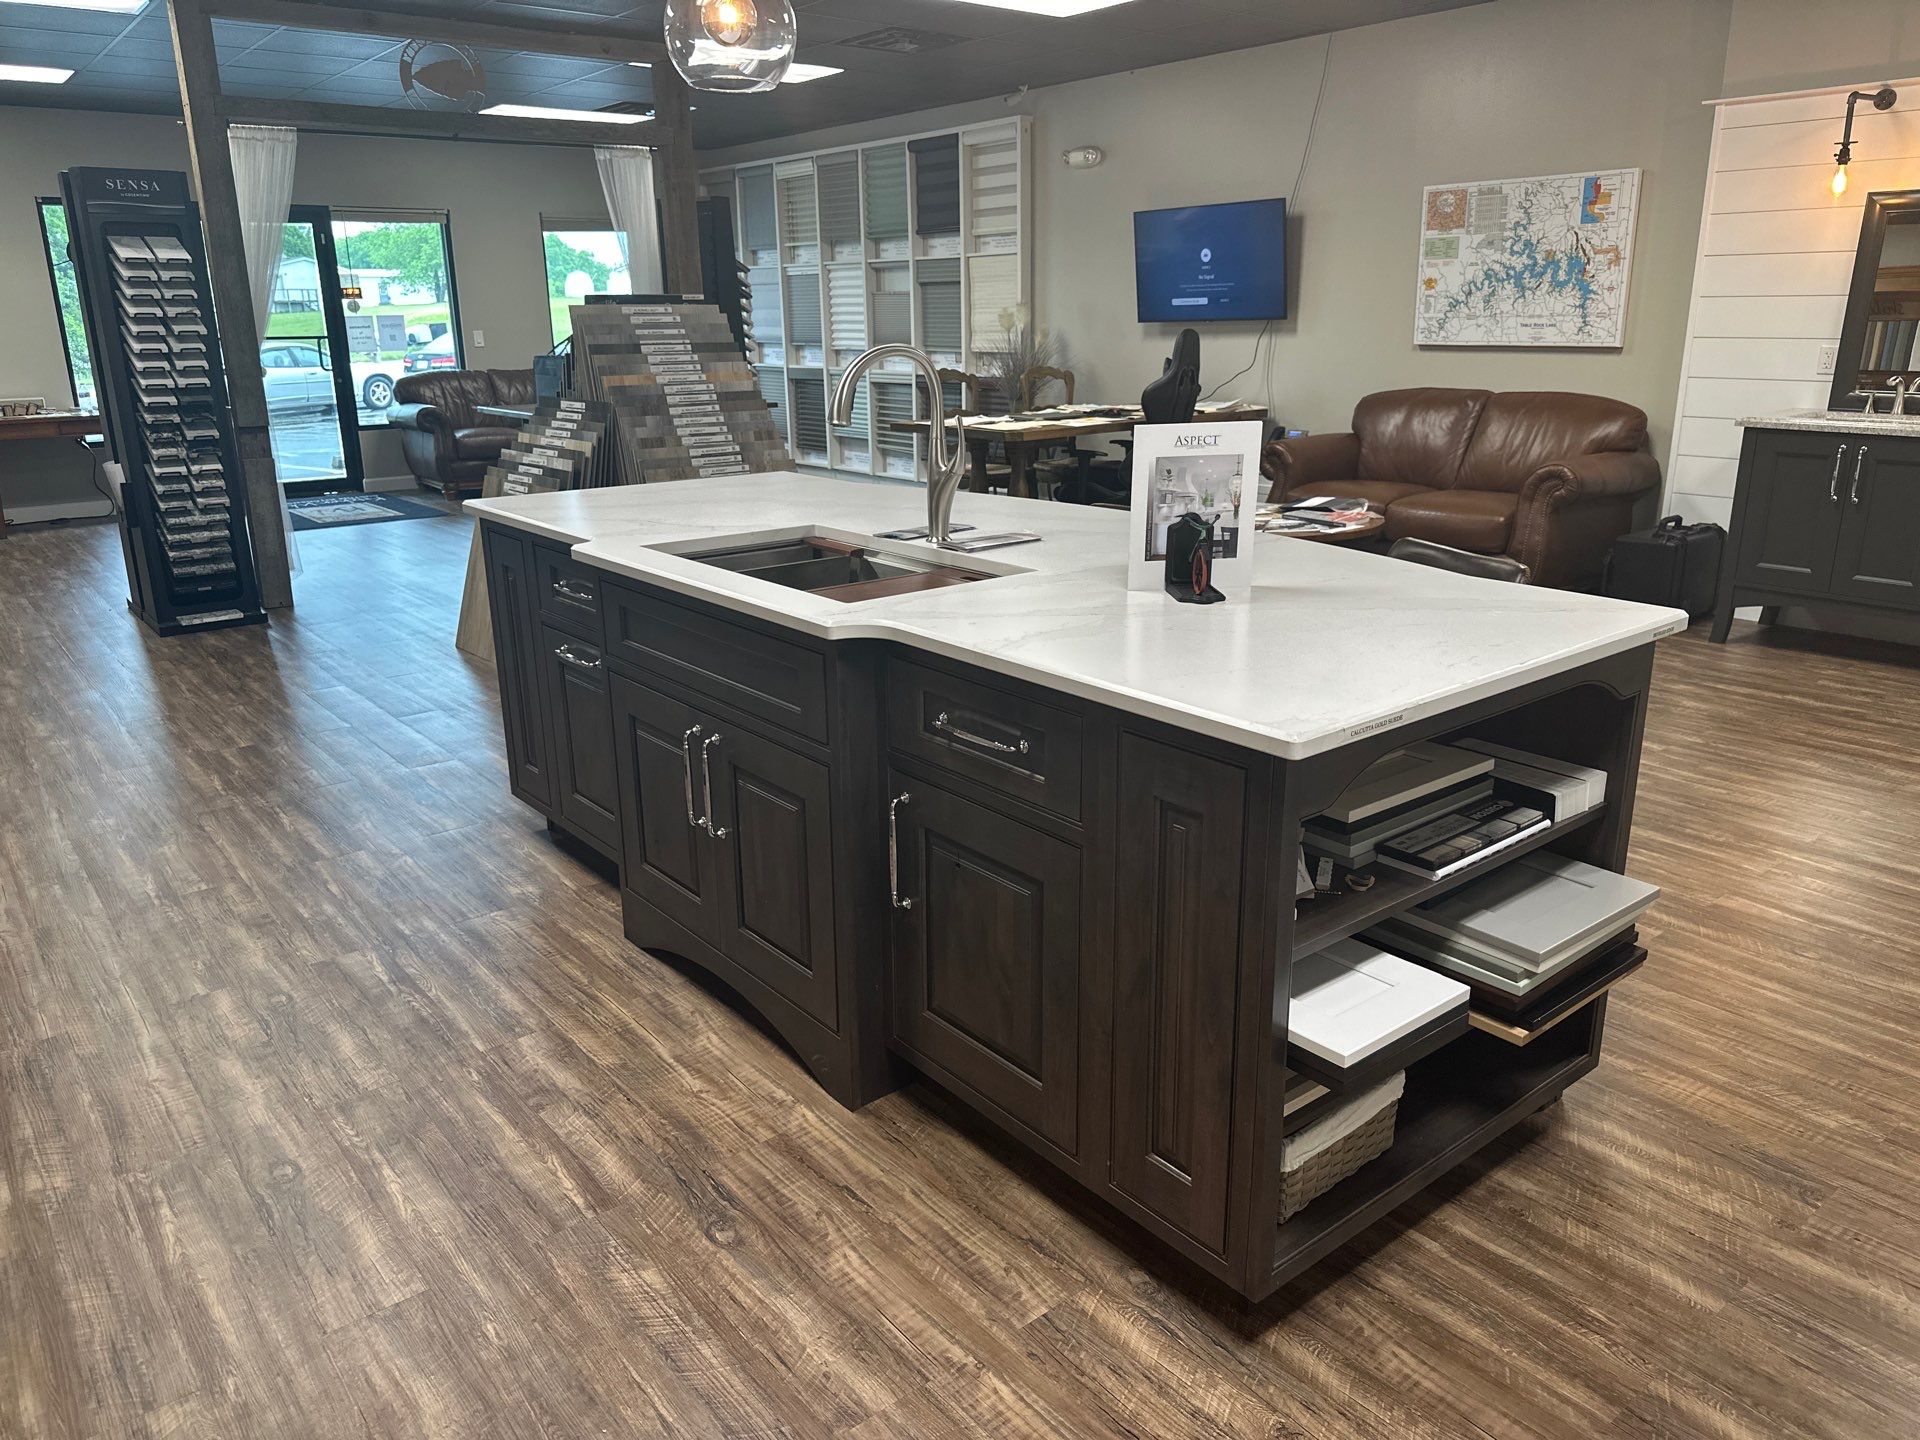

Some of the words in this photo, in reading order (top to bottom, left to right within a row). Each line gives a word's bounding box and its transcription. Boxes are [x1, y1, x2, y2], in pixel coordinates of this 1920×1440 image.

[105, 179, 160, 191] SENSA
[1174, 435, 1222, 446] ASPECT
[1350, 724, 1374, 737] CALCUTTA
[1374, 720, 1388, 729] GOLD
[1388, 714, 1404, 725] SUEDE
